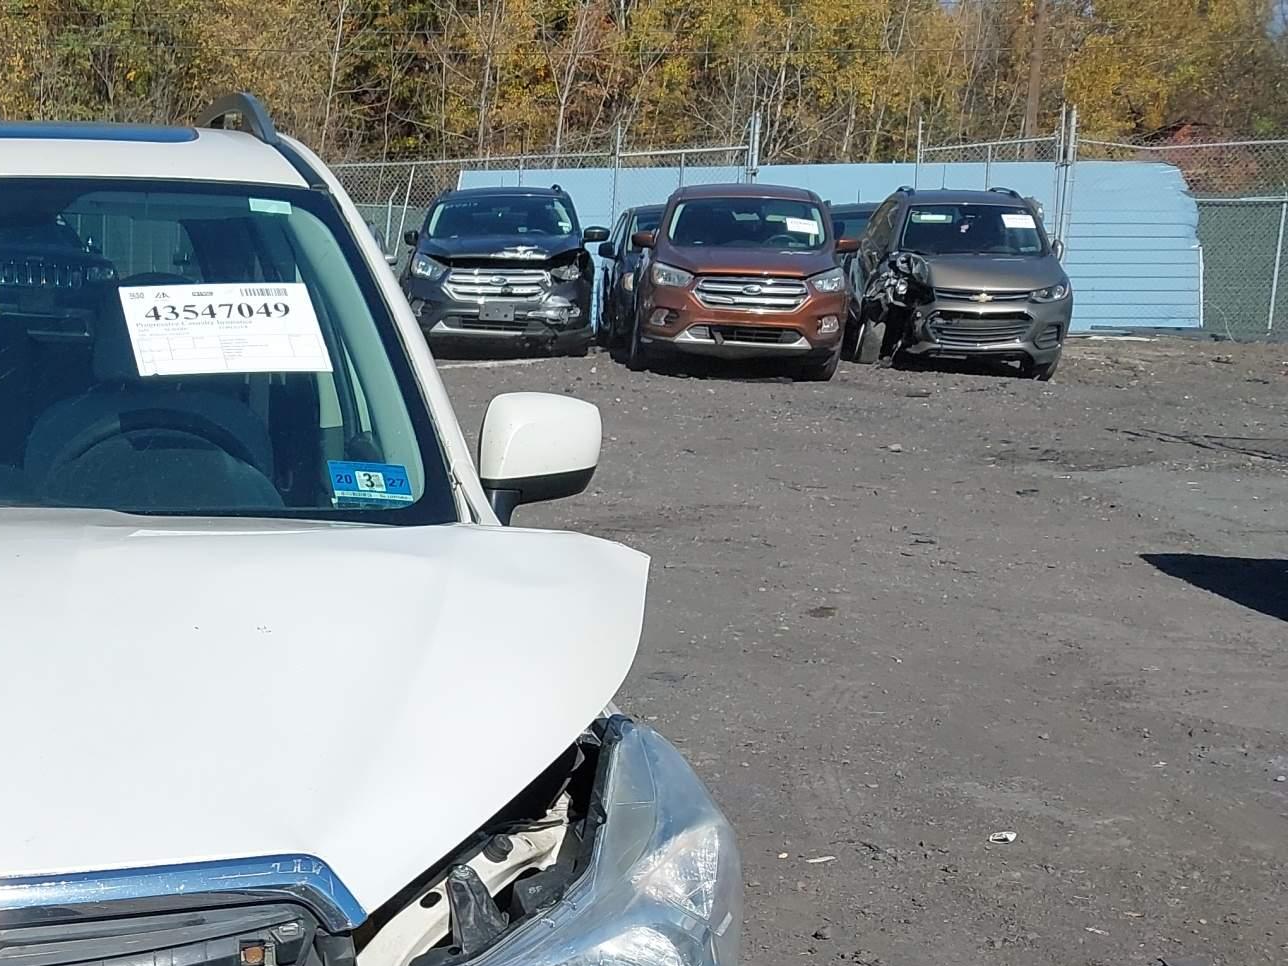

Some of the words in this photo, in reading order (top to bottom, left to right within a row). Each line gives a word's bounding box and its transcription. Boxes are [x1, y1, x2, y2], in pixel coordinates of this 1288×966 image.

[144, 302, 290, 321] 43547049
[336, 473, 353, 485] 20
[362, 472, 375, 488] 3
[387, 477, 405, 488] 27
